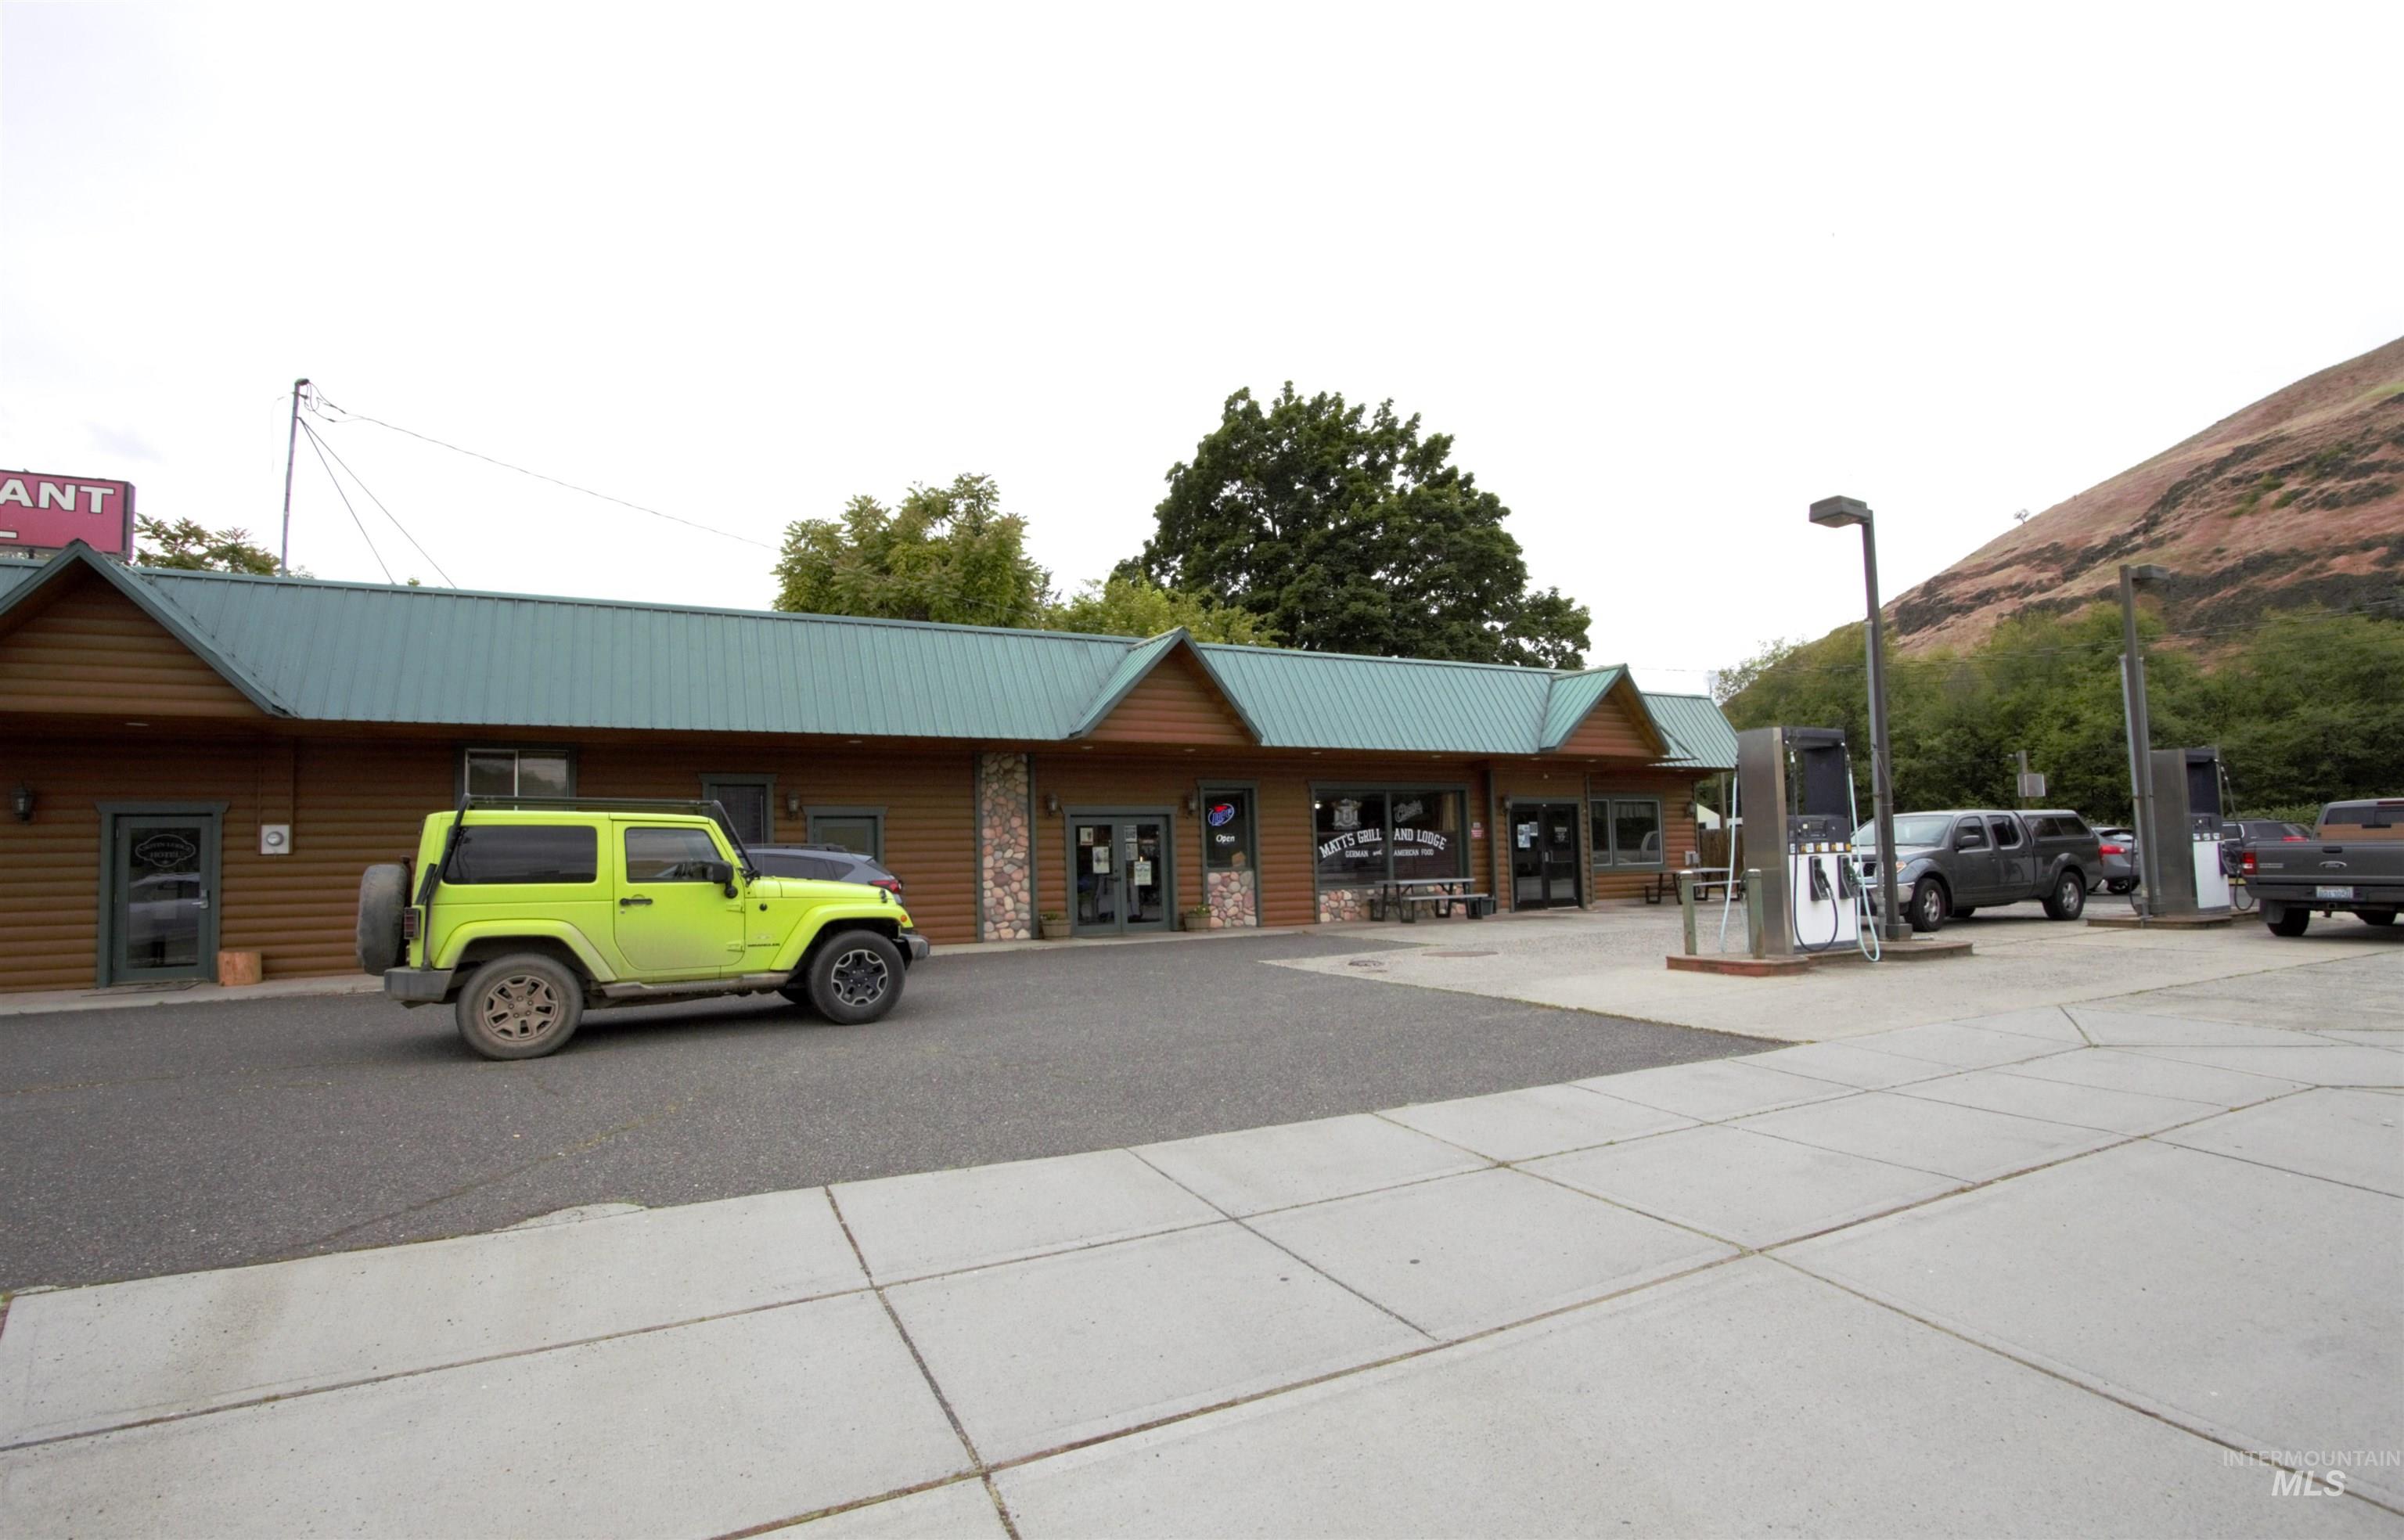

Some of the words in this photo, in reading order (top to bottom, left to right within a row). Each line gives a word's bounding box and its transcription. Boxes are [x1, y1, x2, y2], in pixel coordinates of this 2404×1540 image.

[0, 478, 115, 514] ANT
[1216, 834, 1235, 844] Open
[1319, 833, 1355, 858] MATT'S
[1357, 828, 1382, 844] GRILL
[1394, 828, 1414, 841] AND
[1416, 829, 1447, 851] LODGE
